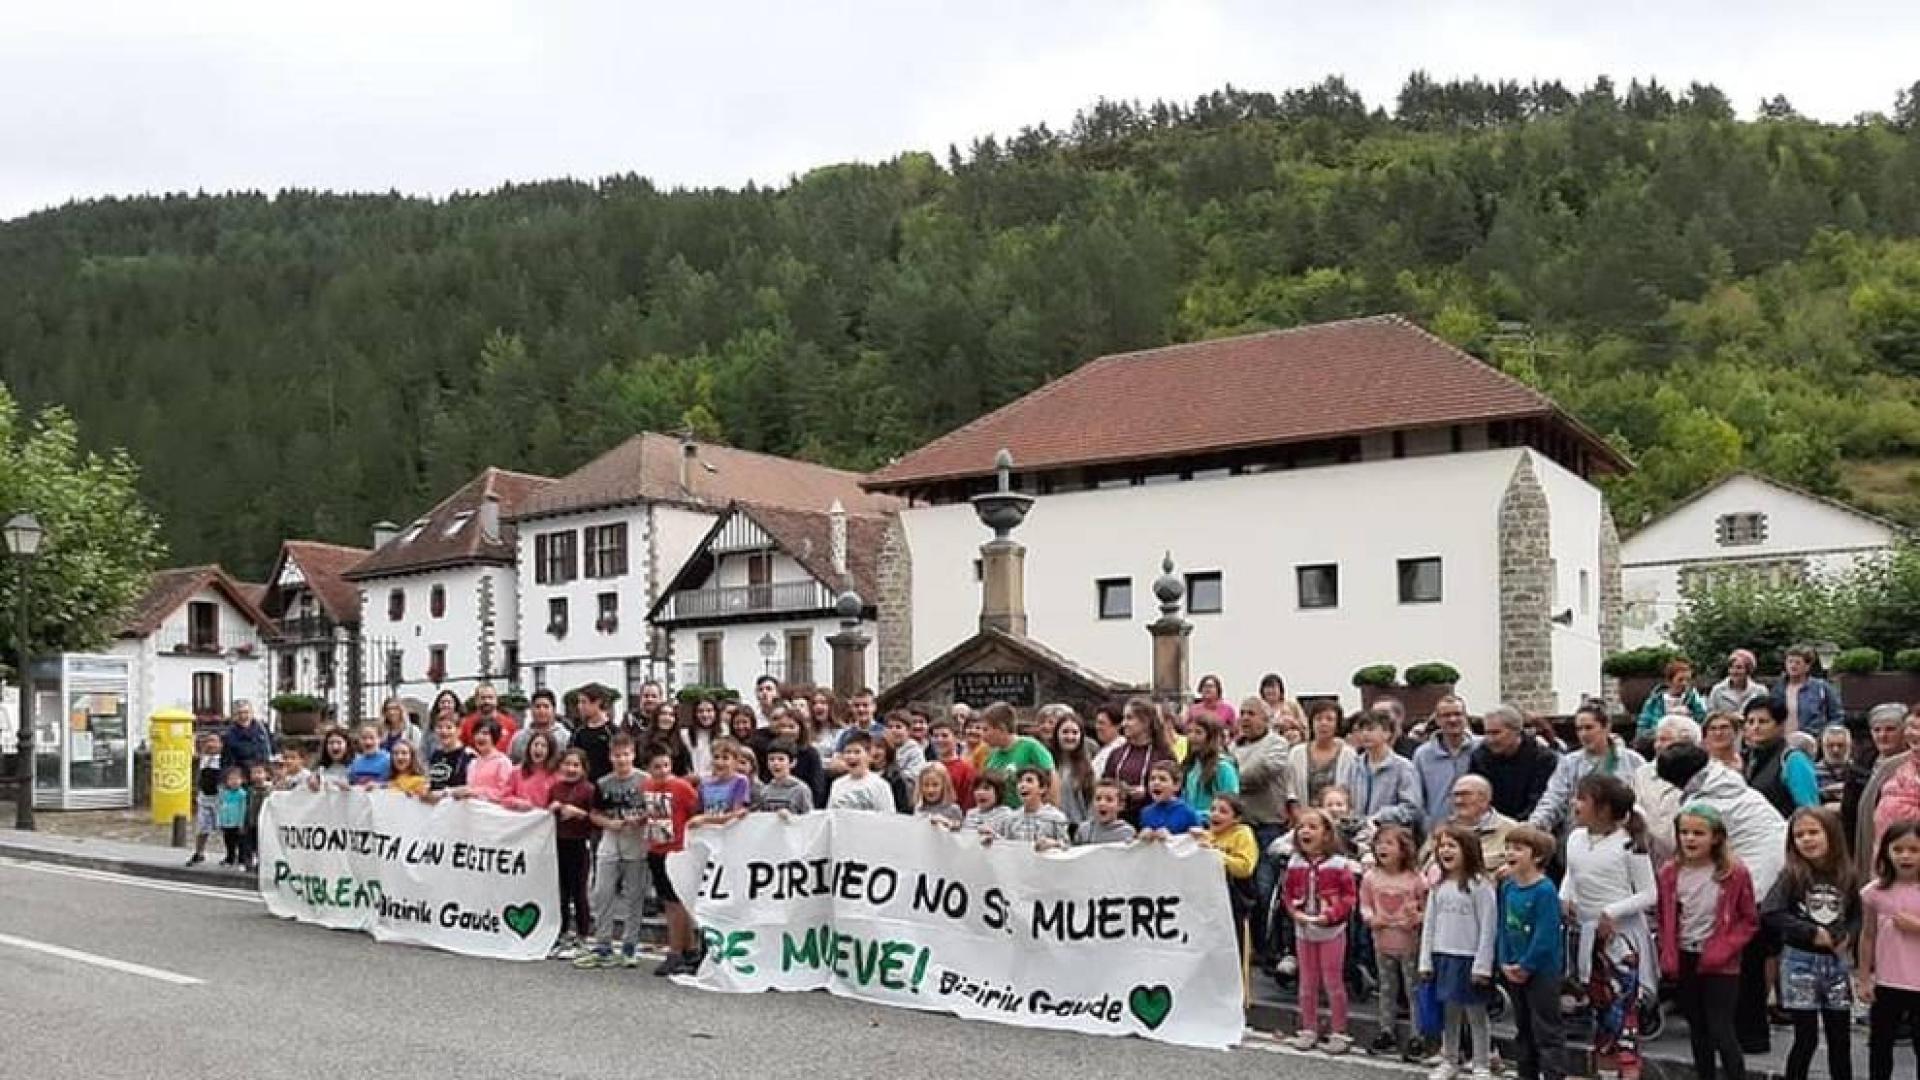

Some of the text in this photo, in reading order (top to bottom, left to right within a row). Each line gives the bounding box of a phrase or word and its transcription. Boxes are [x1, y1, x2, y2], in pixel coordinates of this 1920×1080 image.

[406, 839, 444, 865] LAN
[452, 843, 526, 875] EGITEA
[440, 902, 499, 934] Gaude
[913, 873, 968, 919] NO
[1032, 896, 1188, 944] MUERE,
[1028, 990, 1123, 1023] Gaude
